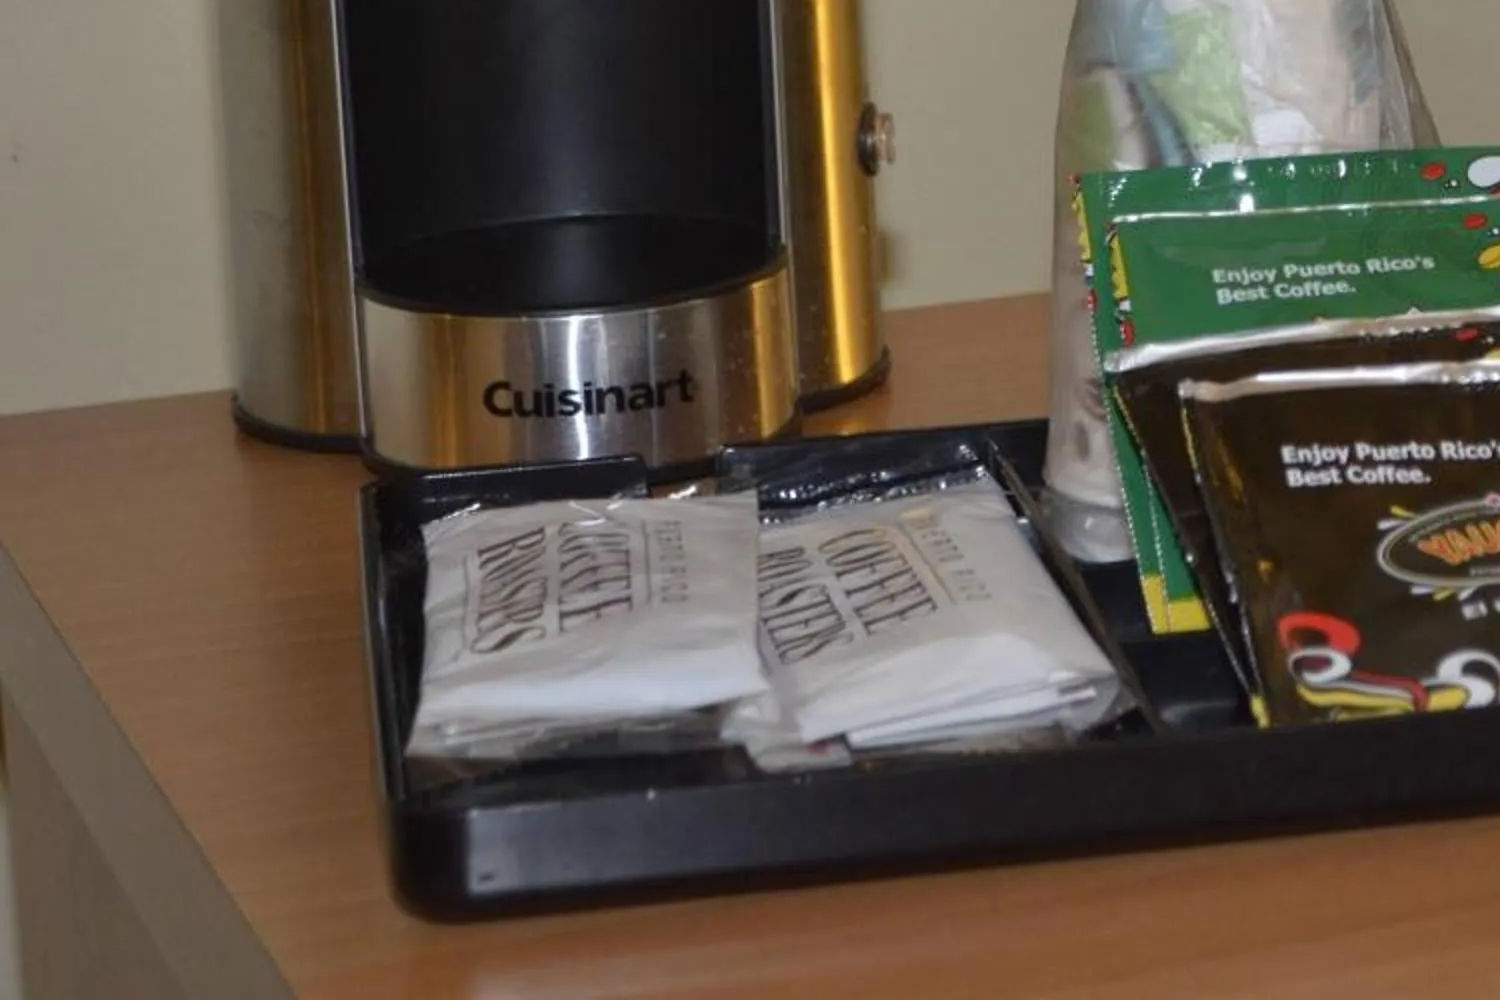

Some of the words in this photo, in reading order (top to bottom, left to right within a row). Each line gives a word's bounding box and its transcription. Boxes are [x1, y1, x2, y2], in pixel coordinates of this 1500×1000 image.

[1211, 267, 1277, 286] Enjoy
[1283, 261, 1361, 279] Puerto
[1365, 255, 1435, 274] Rico's
[1216, 286, 1270, 306] Best
[1274, 280, 1357, 298] Coffee.
[482, 369, 695, 419] Cuisinart
[1281, 444, 1349, 466] Enjoy
[1354, 441, 1436, 462] Puerto
[1286, 466, 1343, 488] Best
[1346, 464, 1432, 484] Coffee.
[818, 528, 938, 637] COFFEE
[757, 545, 855, 665] ROASTERS
[1460, 602, 1488, 621] El
